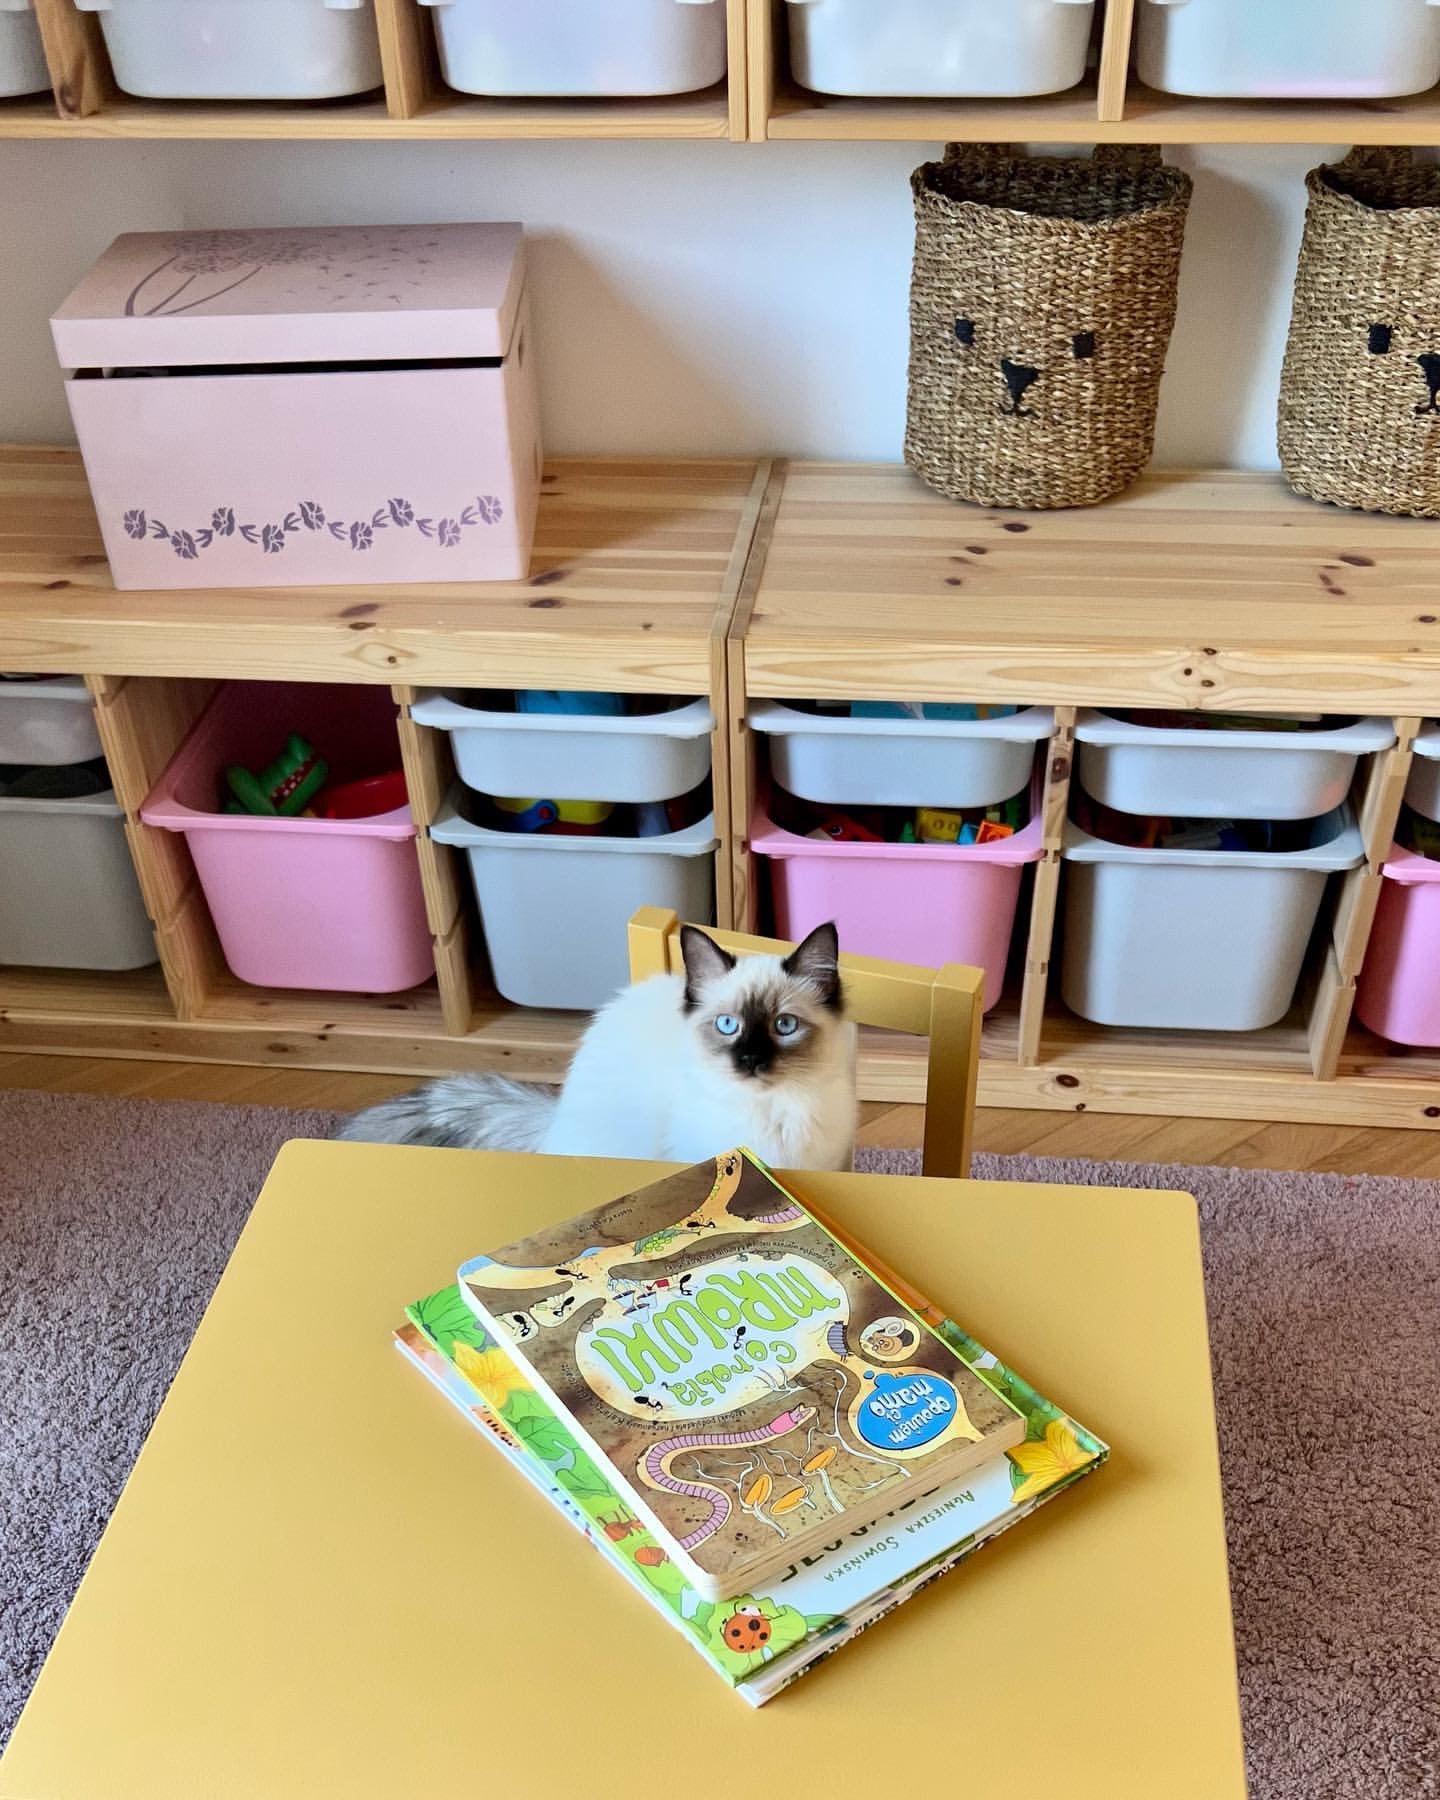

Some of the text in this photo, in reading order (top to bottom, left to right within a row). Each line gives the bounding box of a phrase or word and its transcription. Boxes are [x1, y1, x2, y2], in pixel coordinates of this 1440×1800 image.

[869, 1378, 933, 1417] mamo
[823, 1490, 975, 1582] AGNIESZKA SOWIŃSKA
